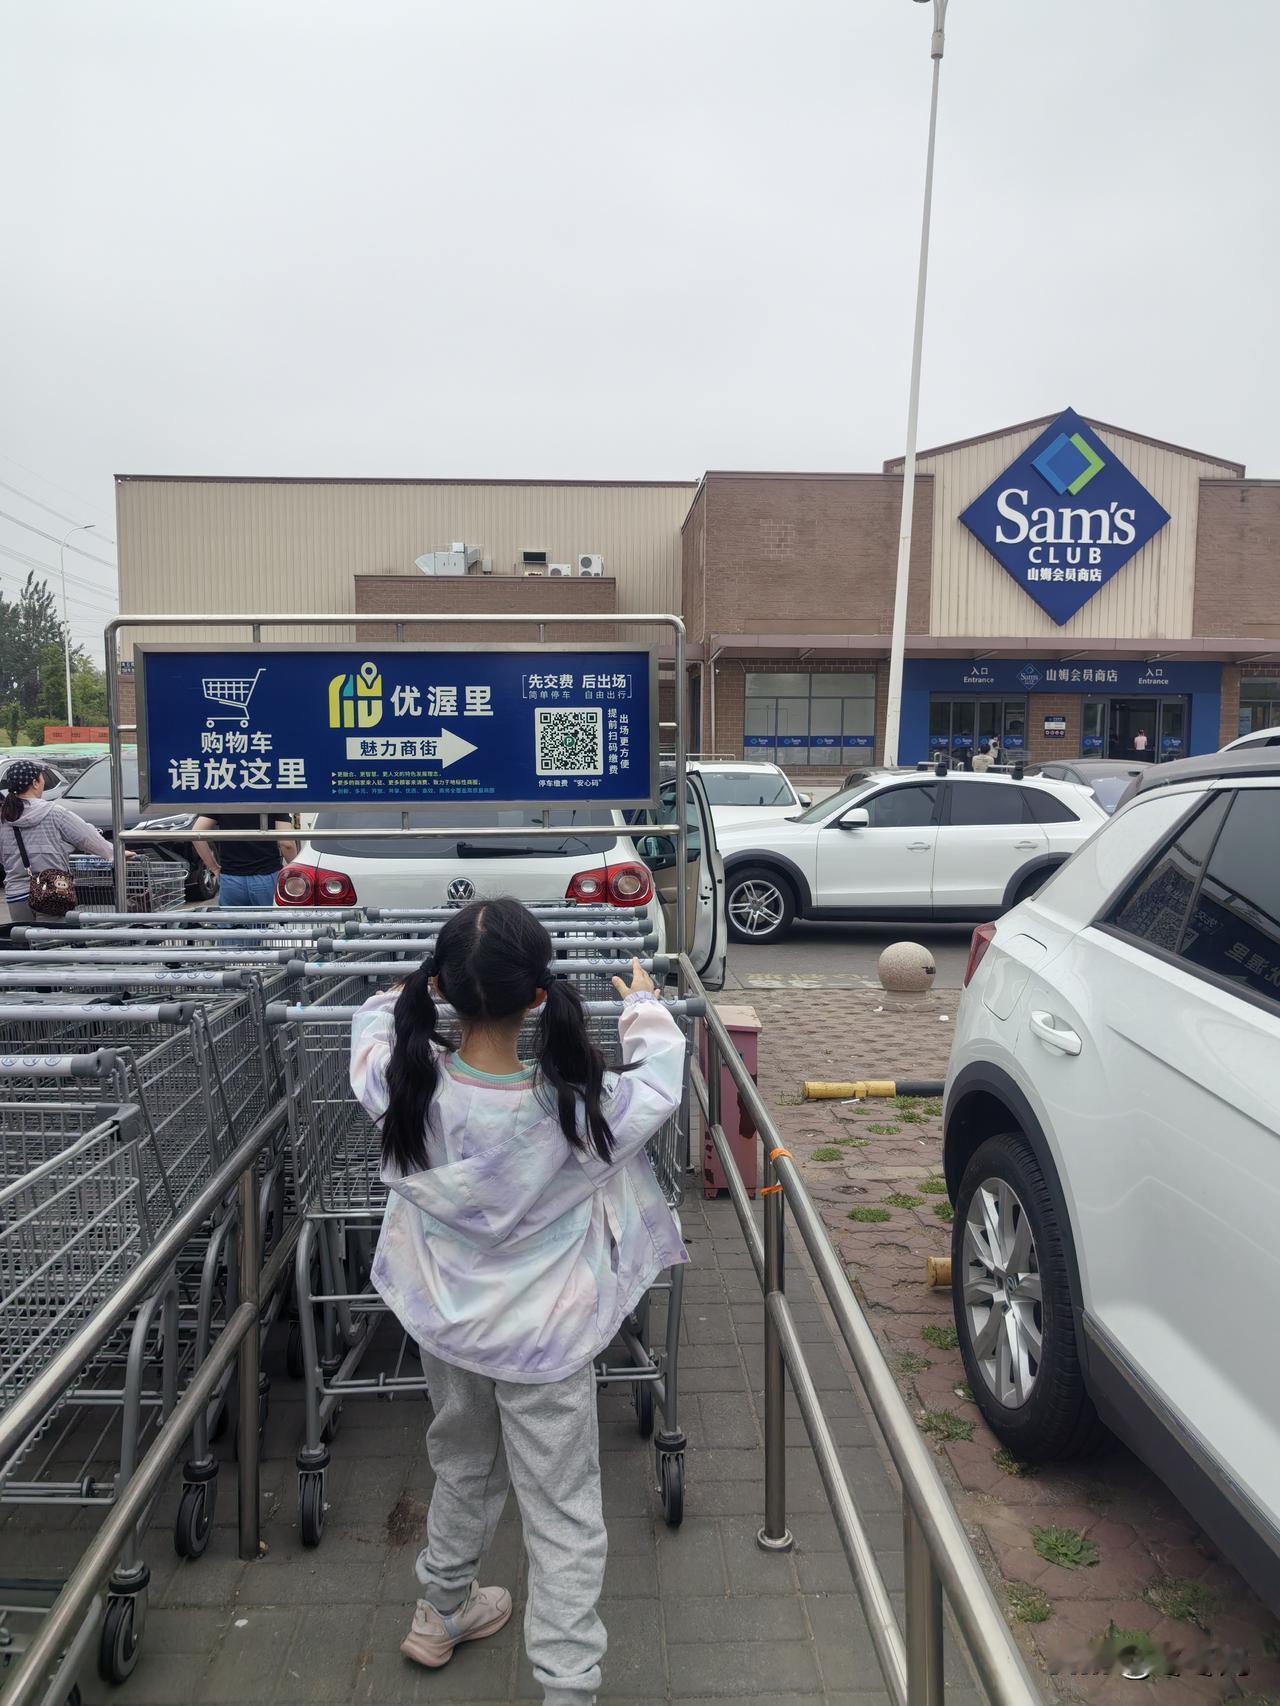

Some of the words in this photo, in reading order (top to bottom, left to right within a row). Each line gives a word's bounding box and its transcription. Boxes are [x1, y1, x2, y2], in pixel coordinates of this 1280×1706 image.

[995, 488, 1136, 545] Sam's
[1028, 547, 1102, 564] CLUB
[1027, 568, 1102, 582] 山姆会员商店
[970, 667, 988, 675] 入口
[1046, 668, 1118, 683] 山姆会员商店
[1145, 668, 1163, 676] 入口
[528, 674, 573, 689] 先交费
[582, 674, 626, 689] 后出场
[963, 676, 994, 684] Entrance
[1138, 677, 1169, 685] Entrance
[390, 685, 494, 717] 优渥里
[528, 690, 571, 700] 简单停车
[584, 690, 627, 700] 自由出行
[201, 731, 273, 754] 购物车
[360, 740, 437, 757] 魅力商街
[607, 708, 618, 775] 提前扫码缴费
[619, 714, 630, 769] 出场更方便
[168, 758, 308, 791] 请放这里
